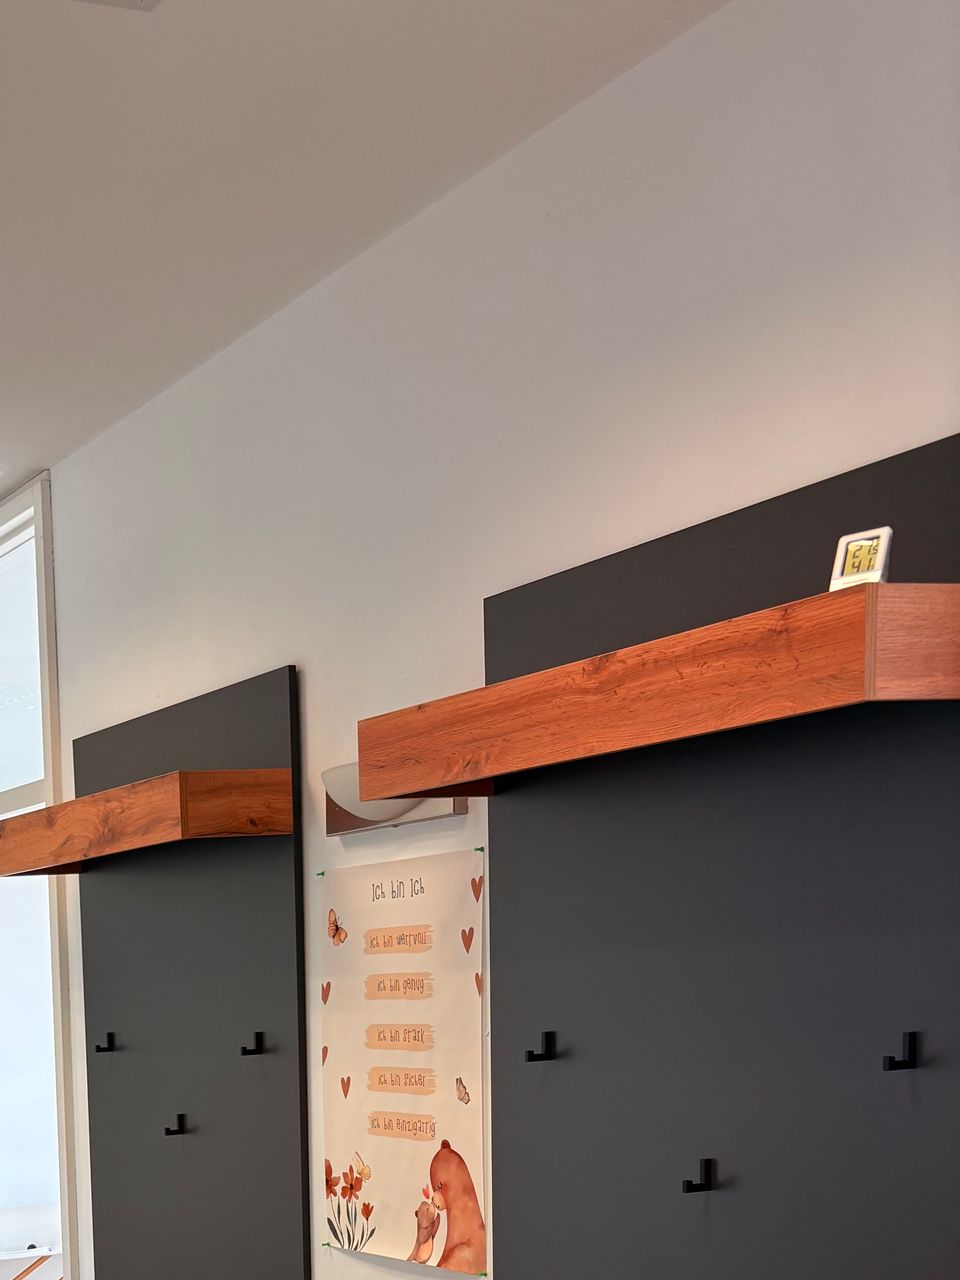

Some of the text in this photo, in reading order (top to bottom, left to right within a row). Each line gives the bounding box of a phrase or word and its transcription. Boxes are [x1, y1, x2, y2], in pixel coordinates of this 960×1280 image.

[371, 877, 425, 902] Ich bin Ich
[383, 934, 394, 948] bin
[396, 931, 427, 947] wertvoll
[389, 978, 400, 992] bin
[403, 977, 425, 995] genug
[389, 1028, 400, 1042] bin
[390, 1073, 401, 1087] bin
[383, 1117, 394, 1131] bin
[396, 1118, 436, 1138] einzigartig
